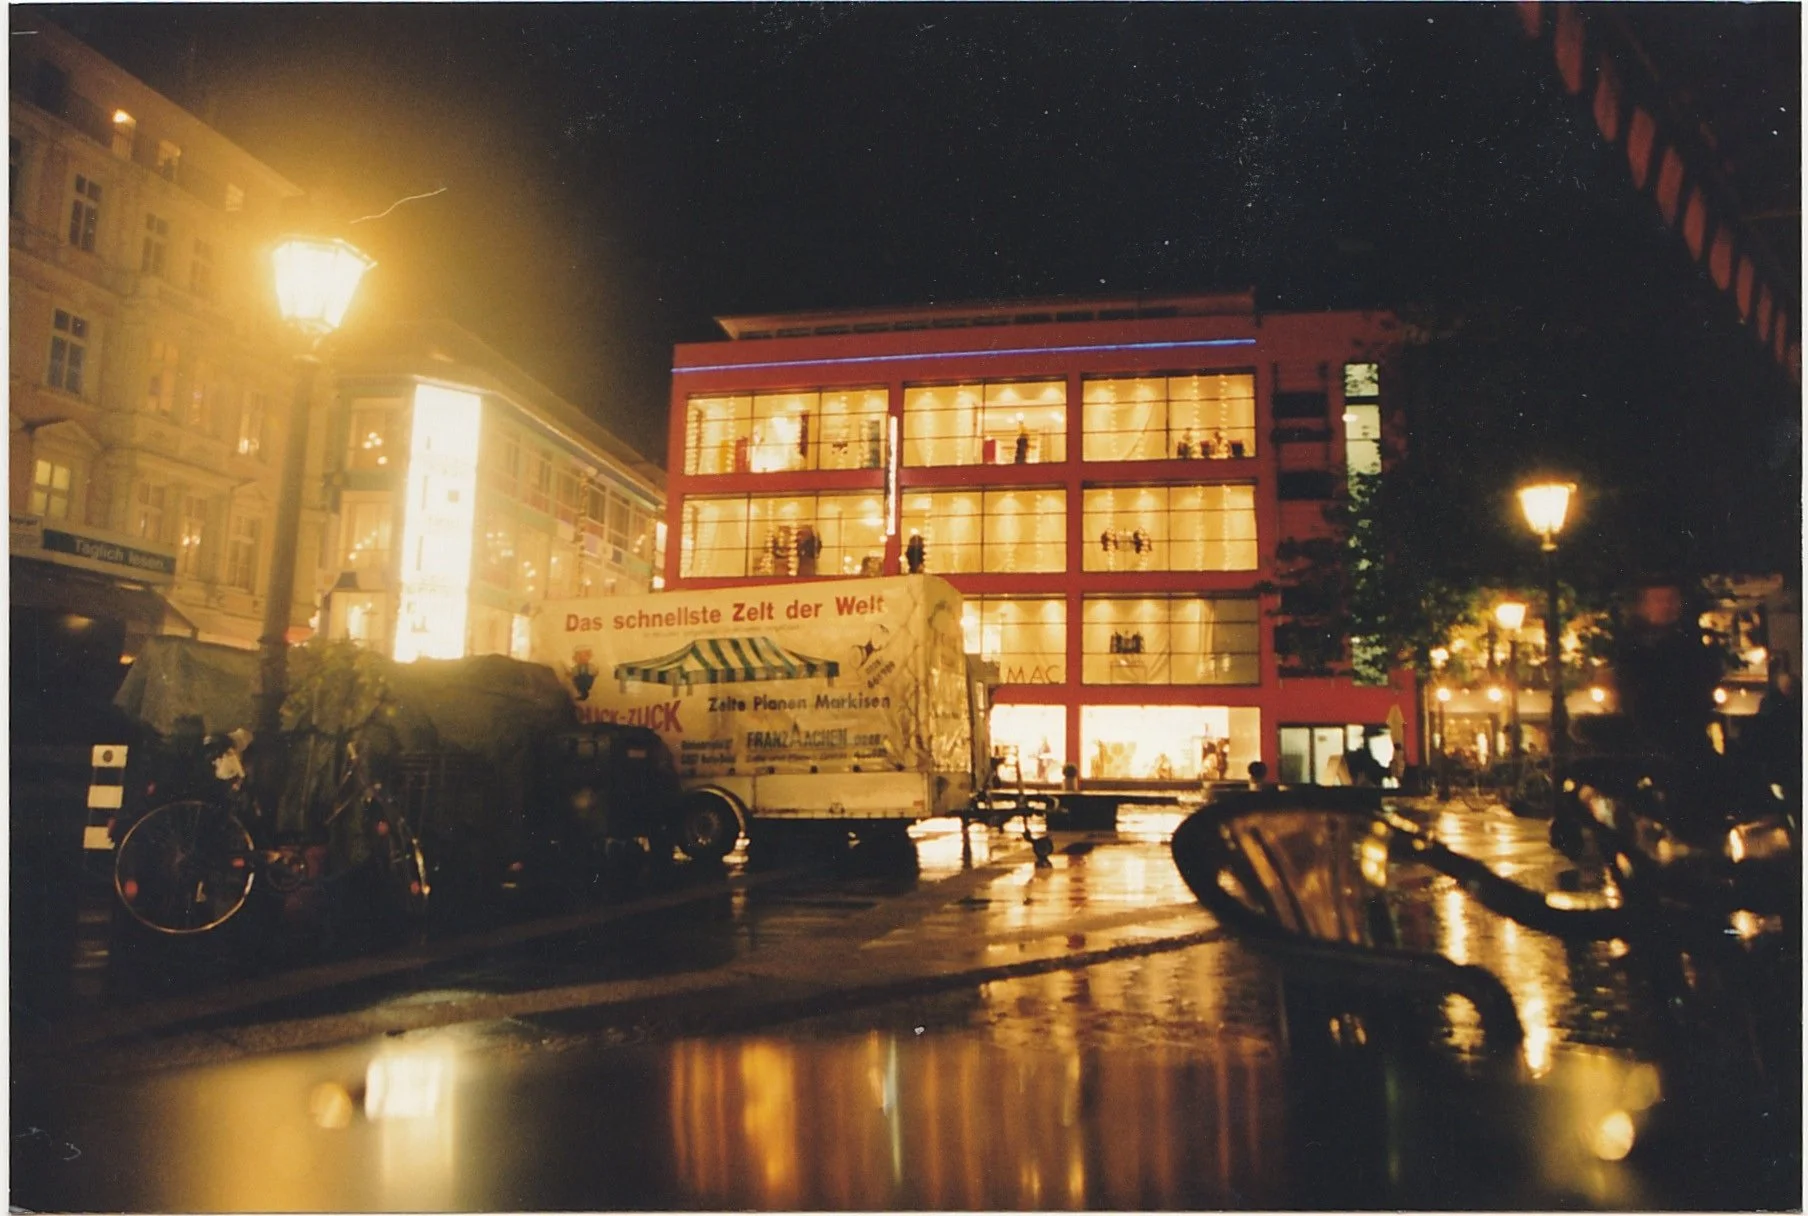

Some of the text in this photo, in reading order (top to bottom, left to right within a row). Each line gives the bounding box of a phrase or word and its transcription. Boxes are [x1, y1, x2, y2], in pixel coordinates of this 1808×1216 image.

[565, 613, 604, 632] Das
[613, 605, 722, 630] schnellste
[732, 601, 775, 622] Zelt
[786, 600, 823, 619] der
[835, 595, 885, 616] Welt
[1007, 664, 1060, 684] MAC
[708, 692, 891, 712] Zelte Planen Markisen
[746, 731, 788, 749] FRANZ
